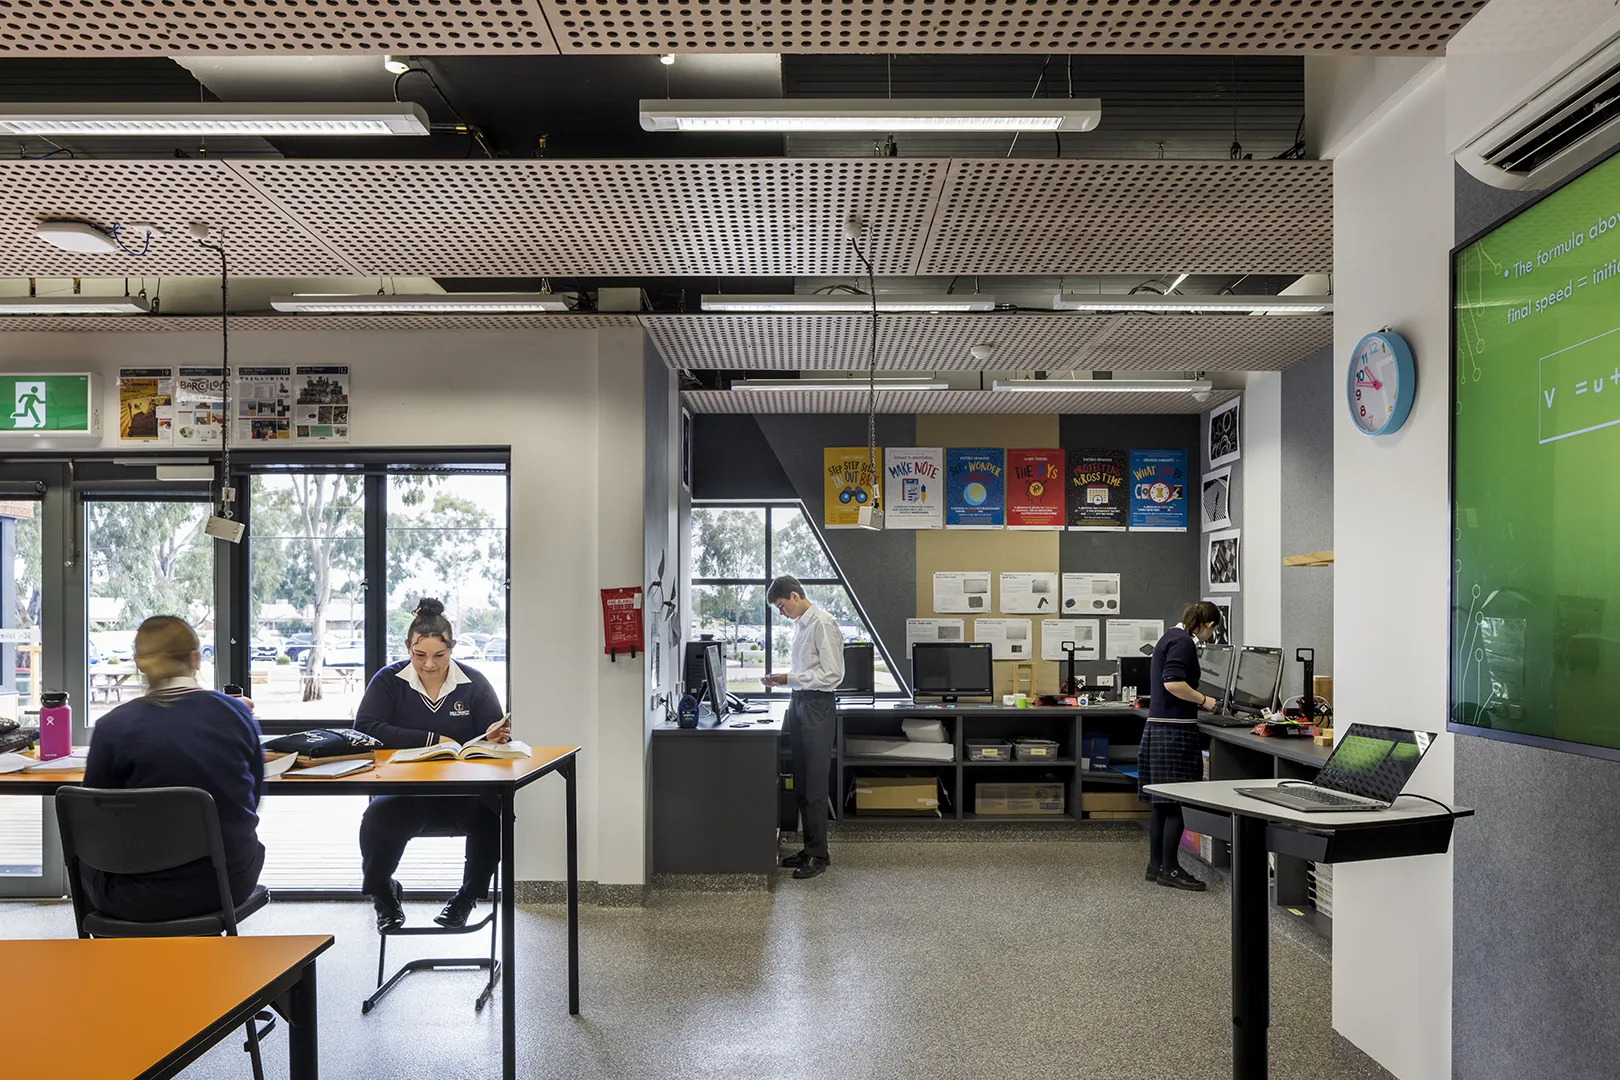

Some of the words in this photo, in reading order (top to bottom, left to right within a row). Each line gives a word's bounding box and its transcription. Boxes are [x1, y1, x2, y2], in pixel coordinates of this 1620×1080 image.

[1513, 262, 1533, 279] The
[1536, 231, 1584, 267] formula
[1506, 299, 1532, 325] final
[1535, 279, 1573, 313] speed
[1361, 352, 1369, 365] 11
[1355, 389, 1362, 401] 9
[1359, 405, 1366, 417] 8
[828, 464, 843, 476] STEP
[843, 460, 860, 471] STEP
[888, 461, 913, 479] MAKE
[914, 460, 940, 479] NOTE
[968, 460, 1002, 477] WONDER
[1014, 464, 1034, 480] THE
[1035, 461, 1045, 477] 3
[1073, 462, 1122, 477] PROJECTING
[1133, 465, 1157, 481] WHAT
[844, 470, 860, 483] OUT
[1072, 471, 1101, 487] ACROSS
[1102, 472, 1124, 487] TIME
